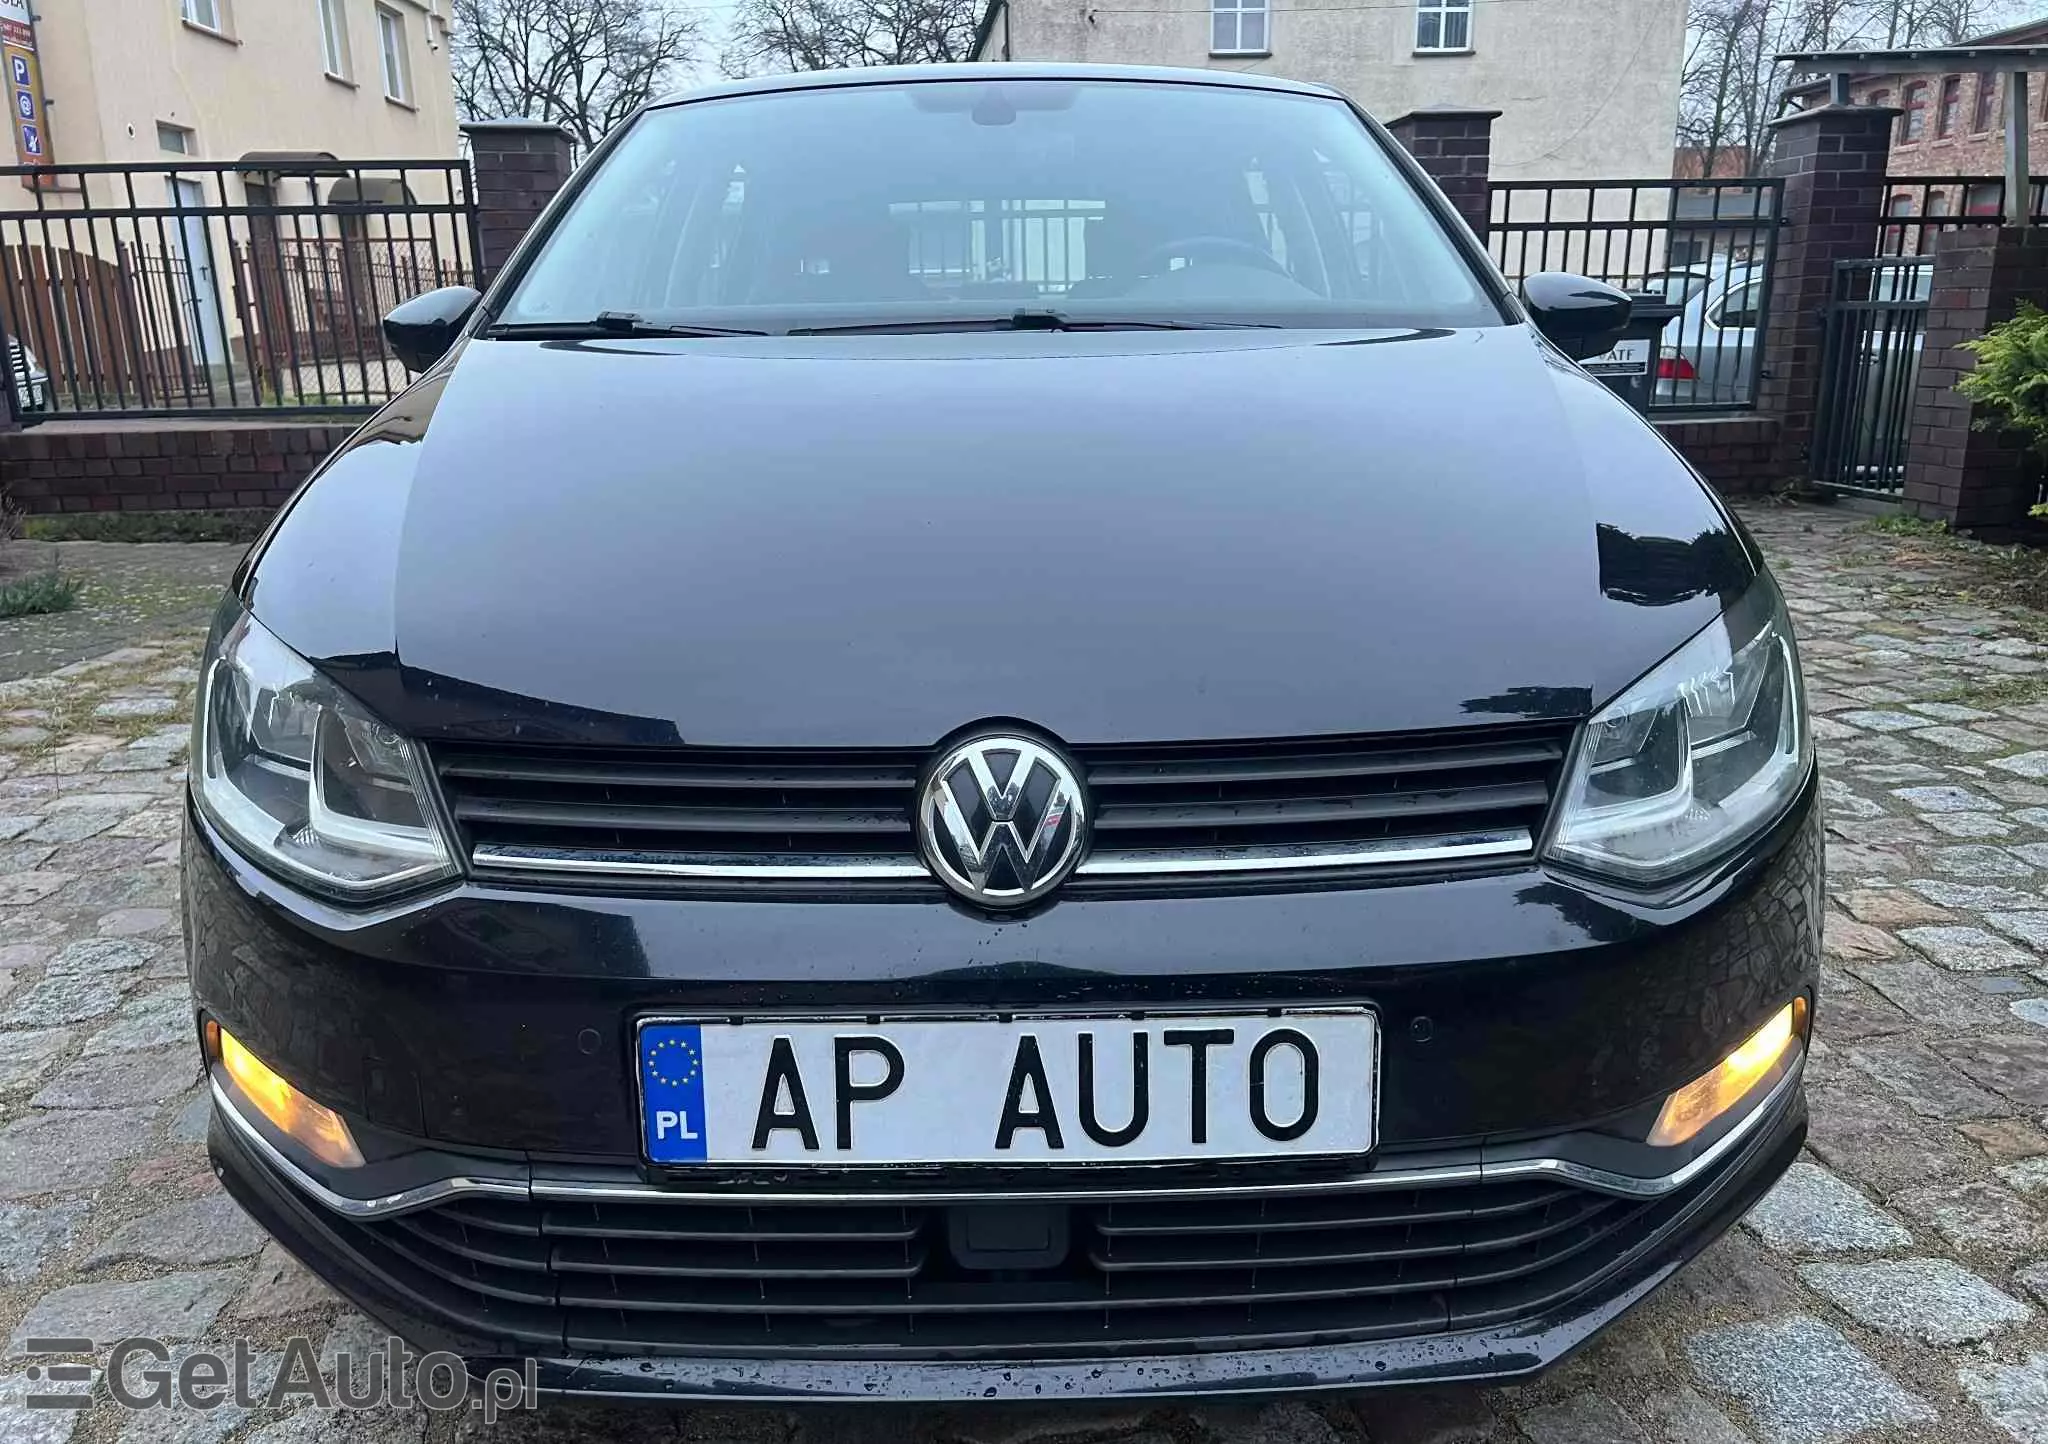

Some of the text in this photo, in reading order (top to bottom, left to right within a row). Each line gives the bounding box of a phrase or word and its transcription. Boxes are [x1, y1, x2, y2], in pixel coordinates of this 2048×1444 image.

[656, 1111, 699, 1141] PL
[752, 1028, 1320, 1151] AP AUTO
